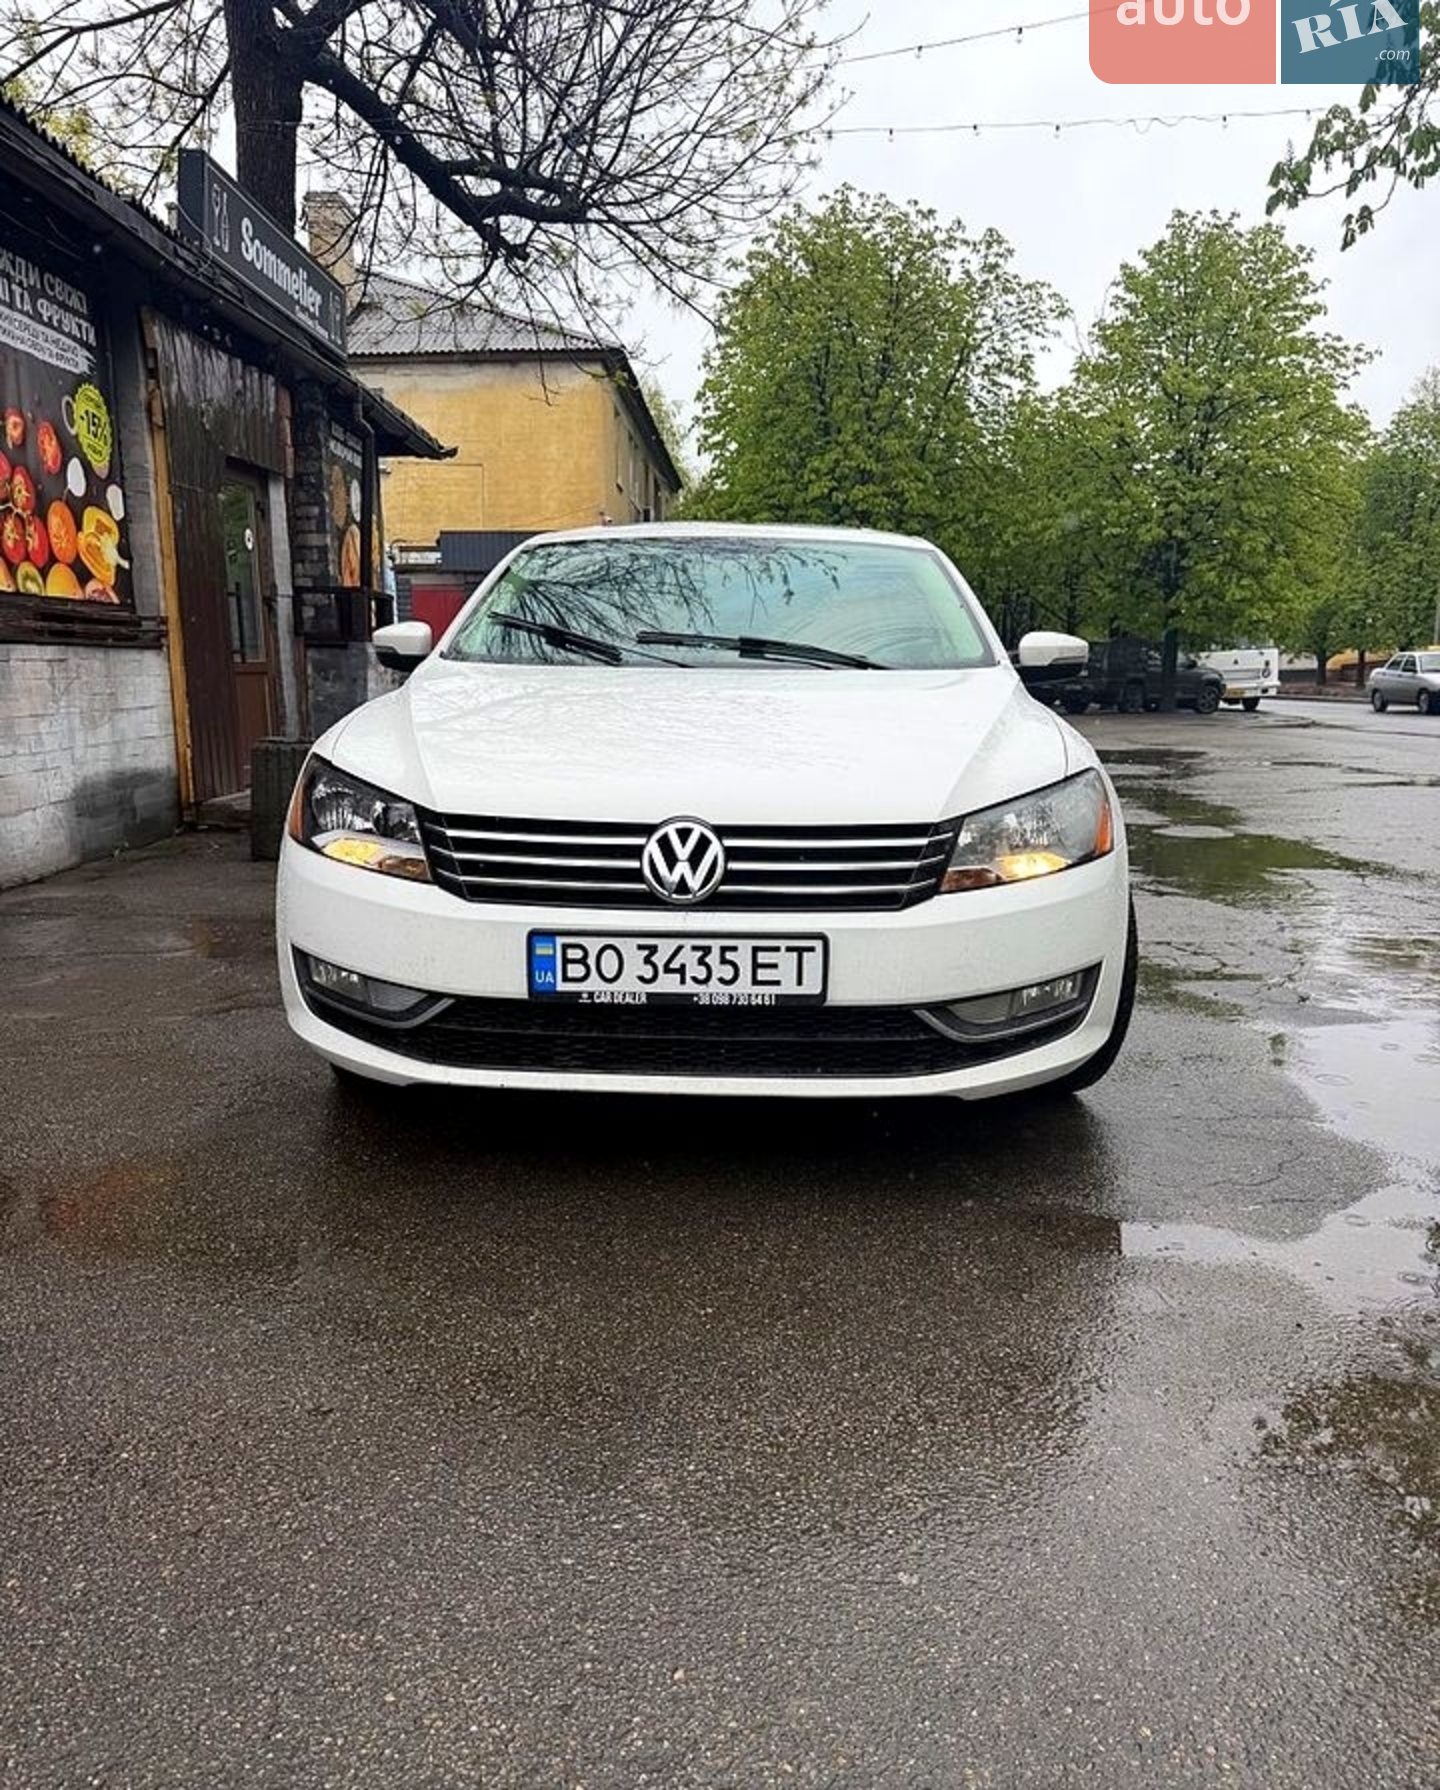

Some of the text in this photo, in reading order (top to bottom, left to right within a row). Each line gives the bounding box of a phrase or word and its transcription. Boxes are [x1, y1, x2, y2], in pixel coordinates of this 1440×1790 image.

[241, 217, 322, 319] Sommelier
[12, 283, 33, 315] ТА
[37, 298, 96, 347] ФРУКТИ
[535, 970, 555, 984] UA
[561, 943, 816, 987] BO 3435 ET
[593, 991, 648, 1005] CAR DEALER
